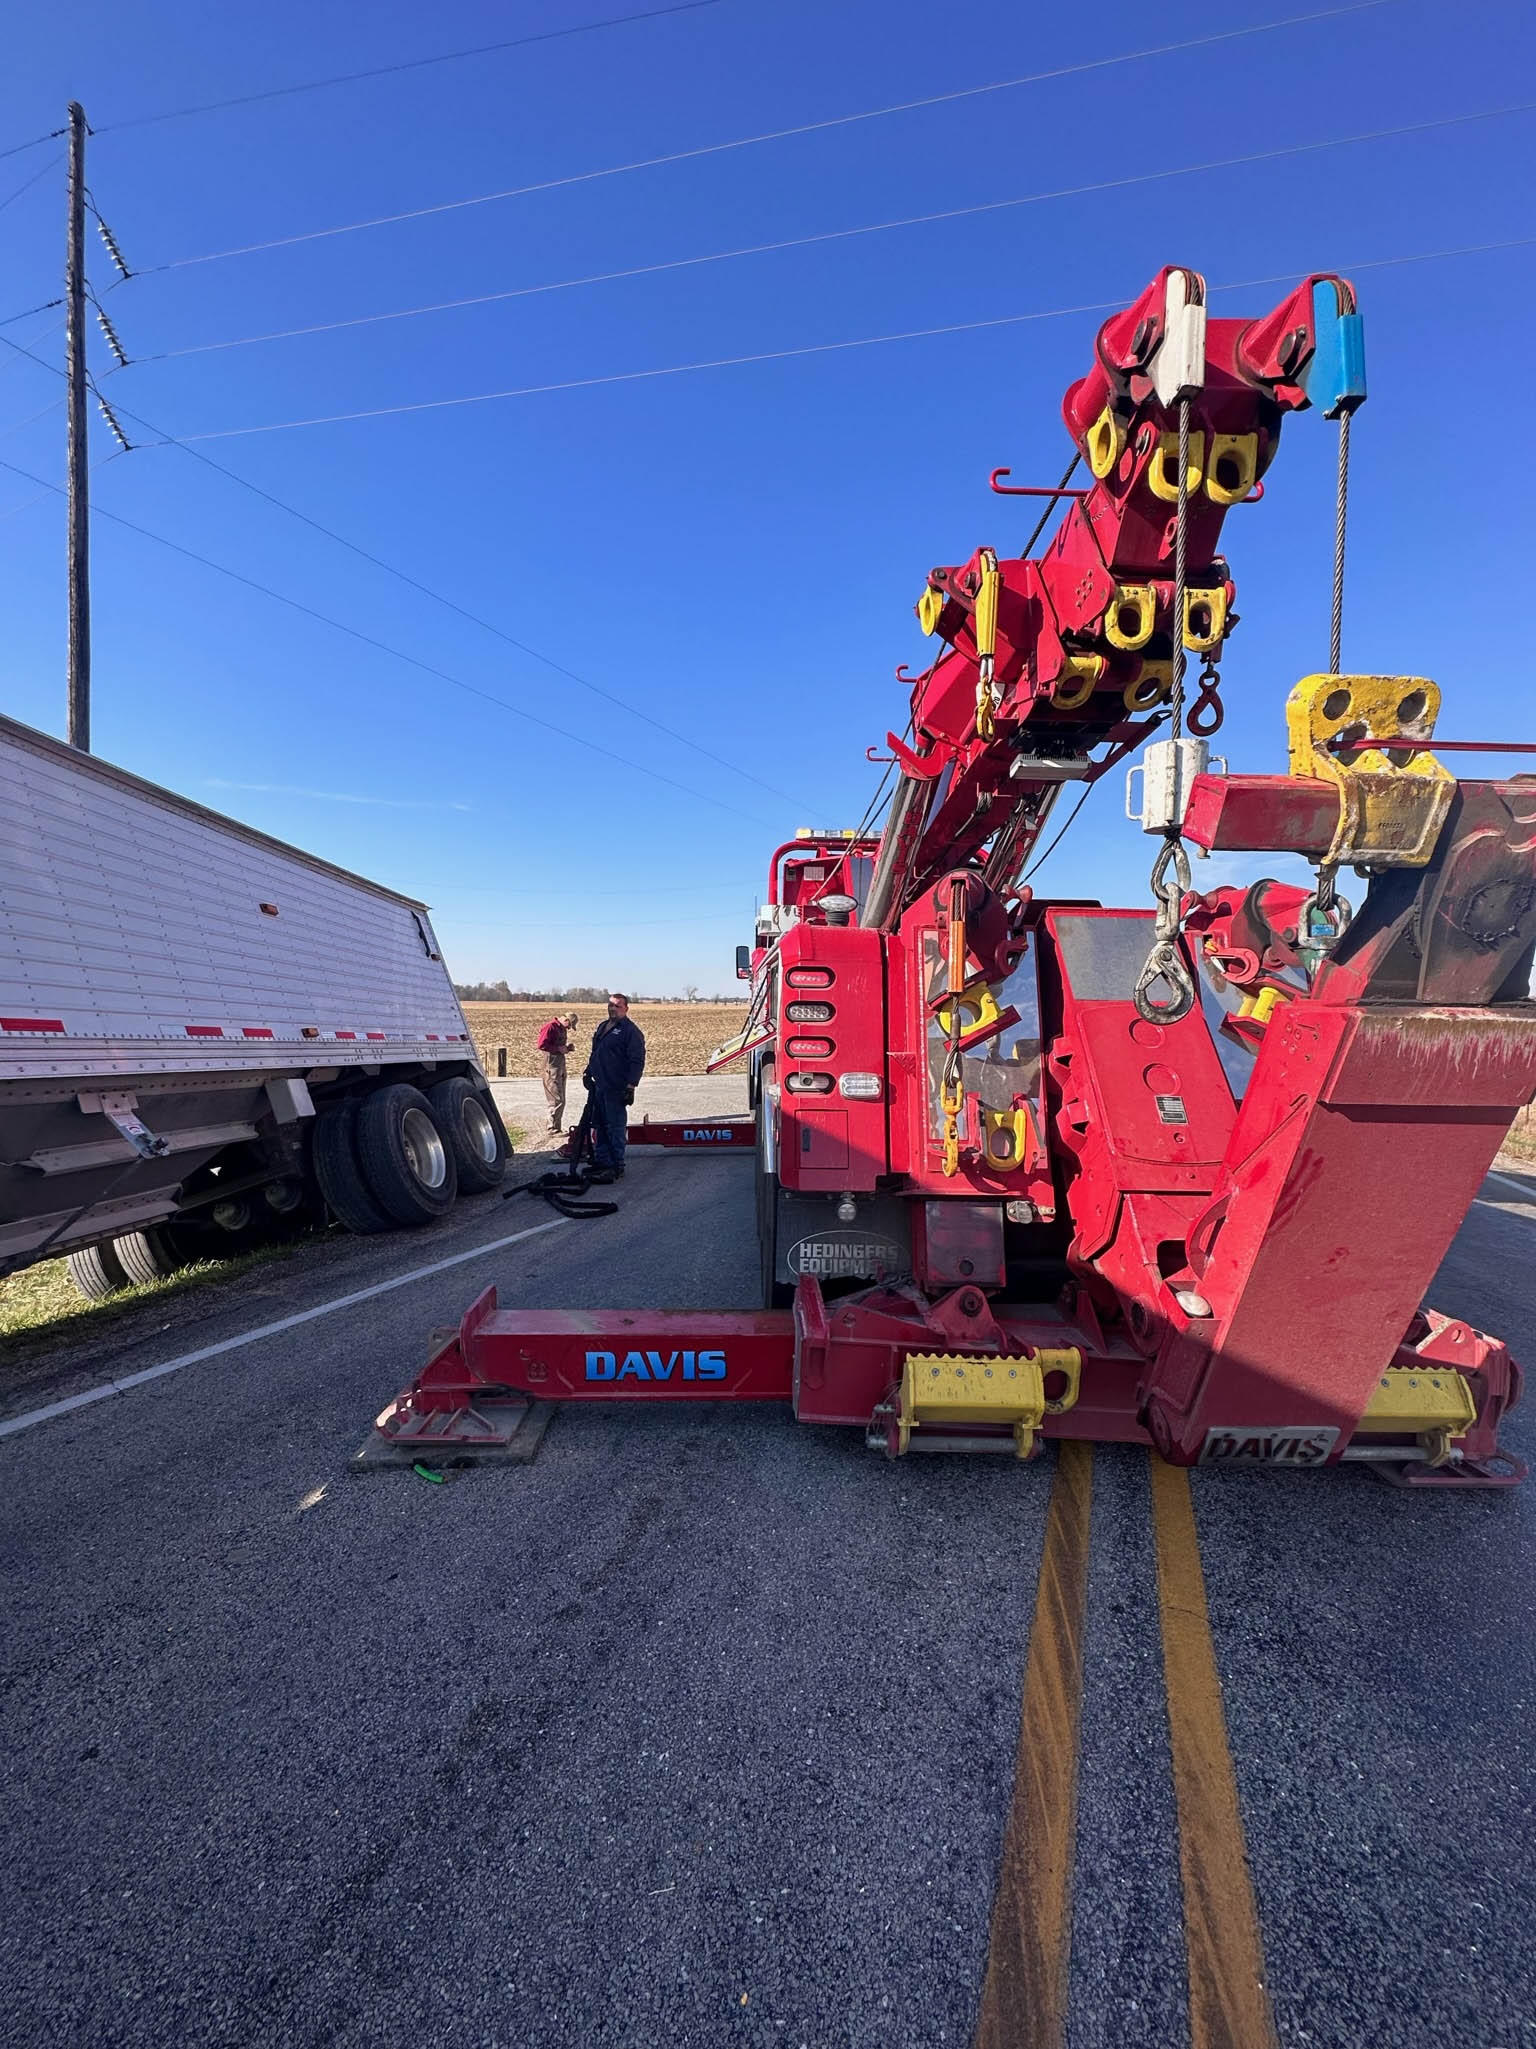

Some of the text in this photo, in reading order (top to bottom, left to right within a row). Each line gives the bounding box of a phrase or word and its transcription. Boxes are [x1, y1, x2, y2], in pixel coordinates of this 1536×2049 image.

[683, 1129, 732, 1141] DAVIS
[800, 1243, 898, 1258] HEDINGERS
[800, 1258, 898, 1273] EQUIPM
[585, 1351, 727, 1380] DAVIS
[1204, 1438, 1330, 1460] DAVIS
